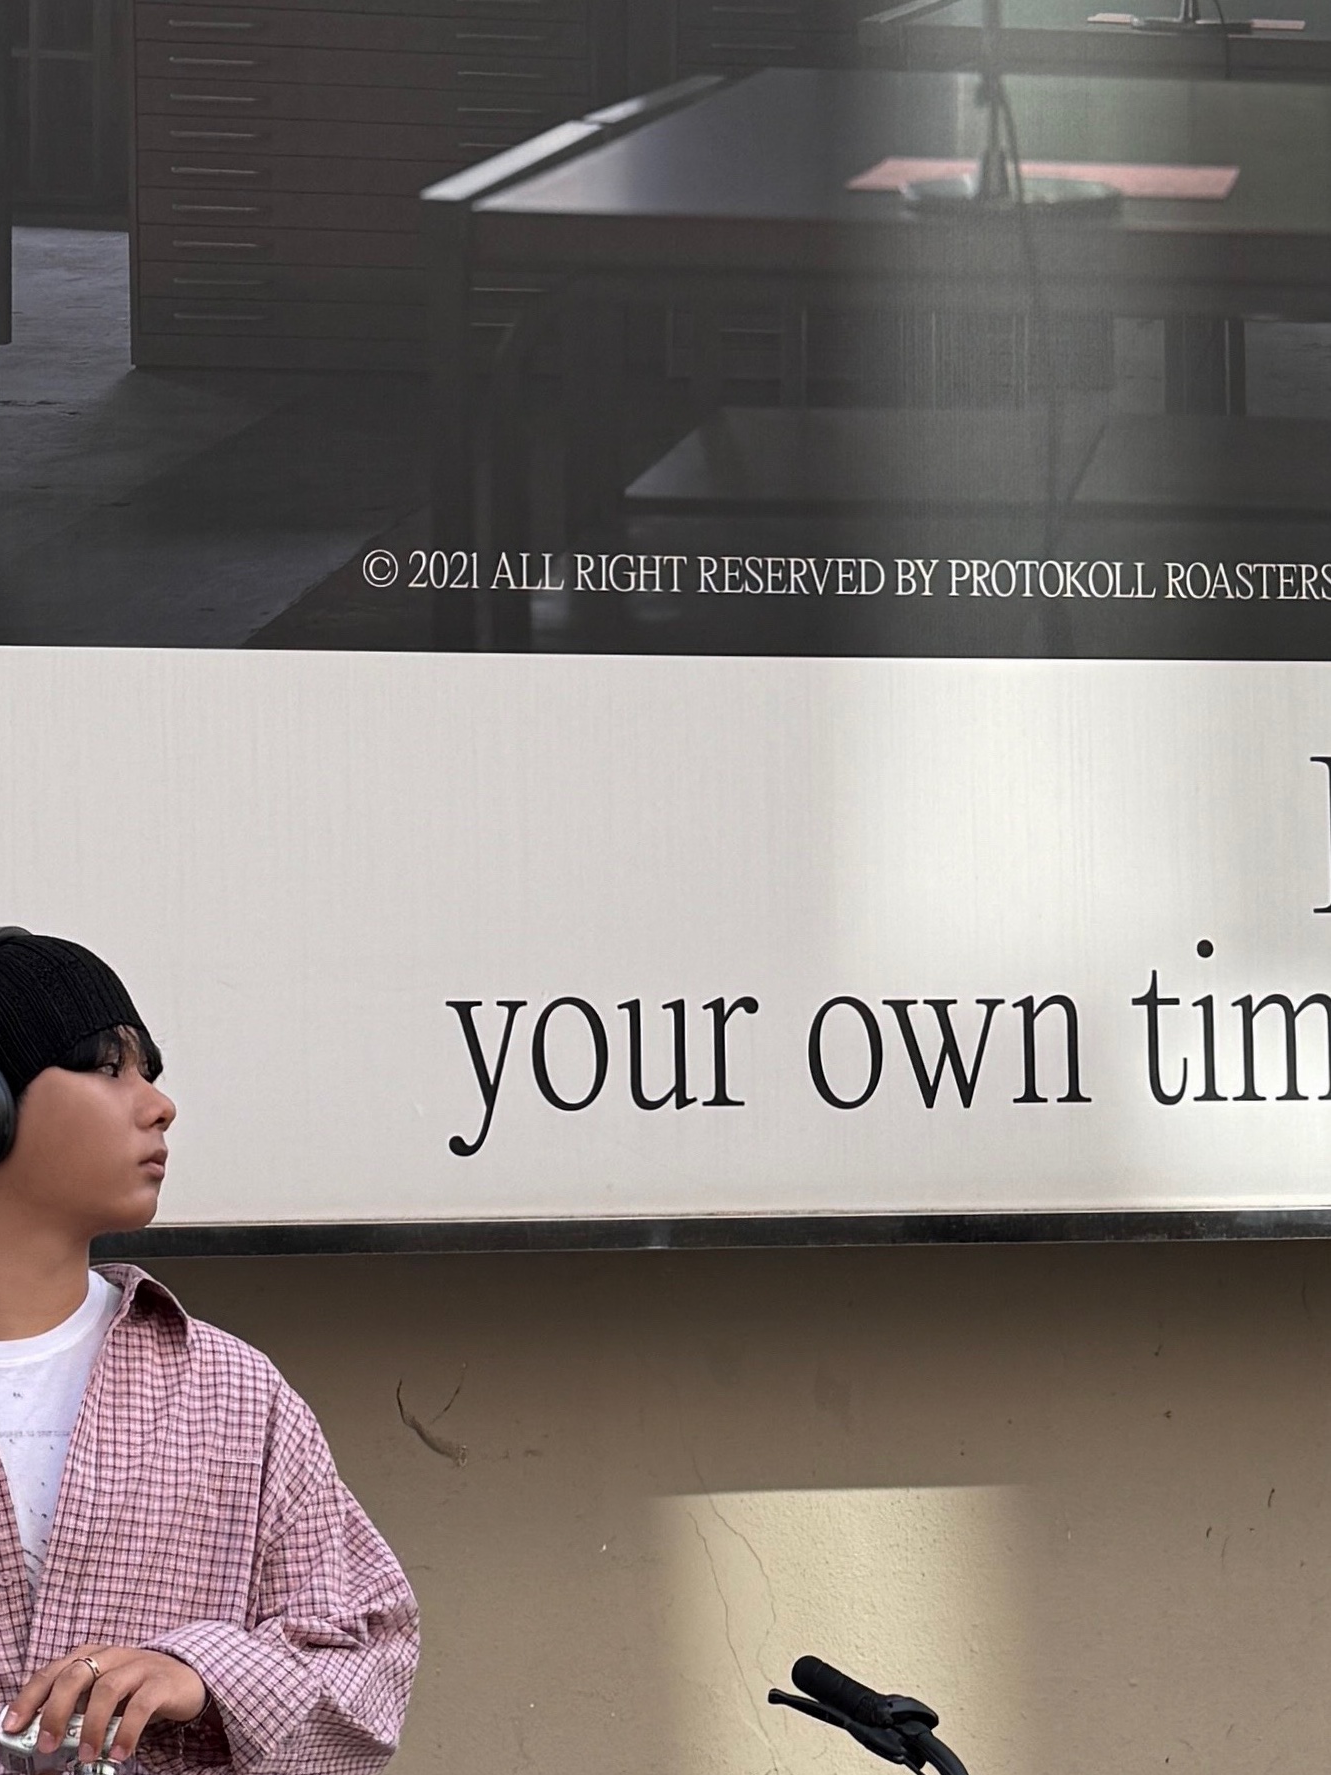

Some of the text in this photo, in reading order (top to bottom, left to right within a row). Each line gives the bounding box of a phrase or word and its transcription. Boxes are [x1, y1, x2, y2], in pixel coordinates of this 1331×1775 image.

[407, 550, 480, 588] 2021
[489, 551, 564, 590] ALL
[573, 553, 687, 592] RIGHT
[696, 556, 885, 595] RESERVED
[893, 558, 939, 595] BY
[946, 559, 1156, 598] PROTOKOLL
[1164, 561, 1331, 600] ROASTERS
[445, 996, 759, 1157] your
[808, 994, 1092, 1110] own
